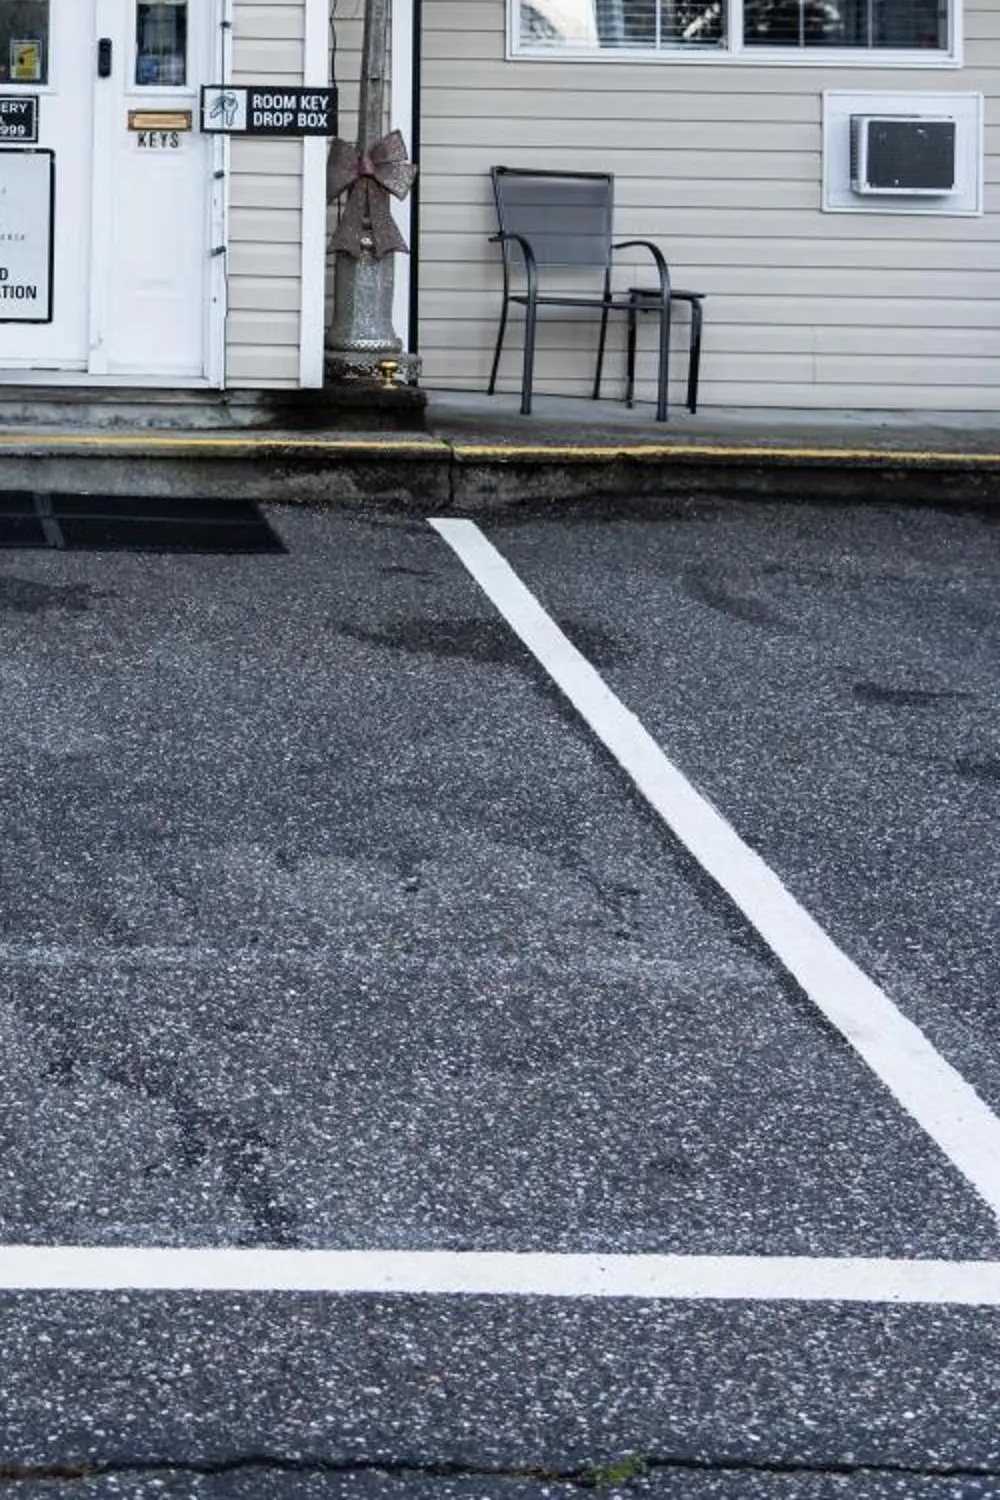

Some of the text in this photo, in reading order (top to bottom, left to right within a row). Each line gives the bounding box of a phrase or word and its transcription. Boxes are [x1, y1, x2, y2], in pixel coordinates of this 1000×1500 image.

[253, 94, 329, 111] ROOM KEY
[253, 112, 328, 128] DROP BOX
[137, 132, 181, 149] KEYS
